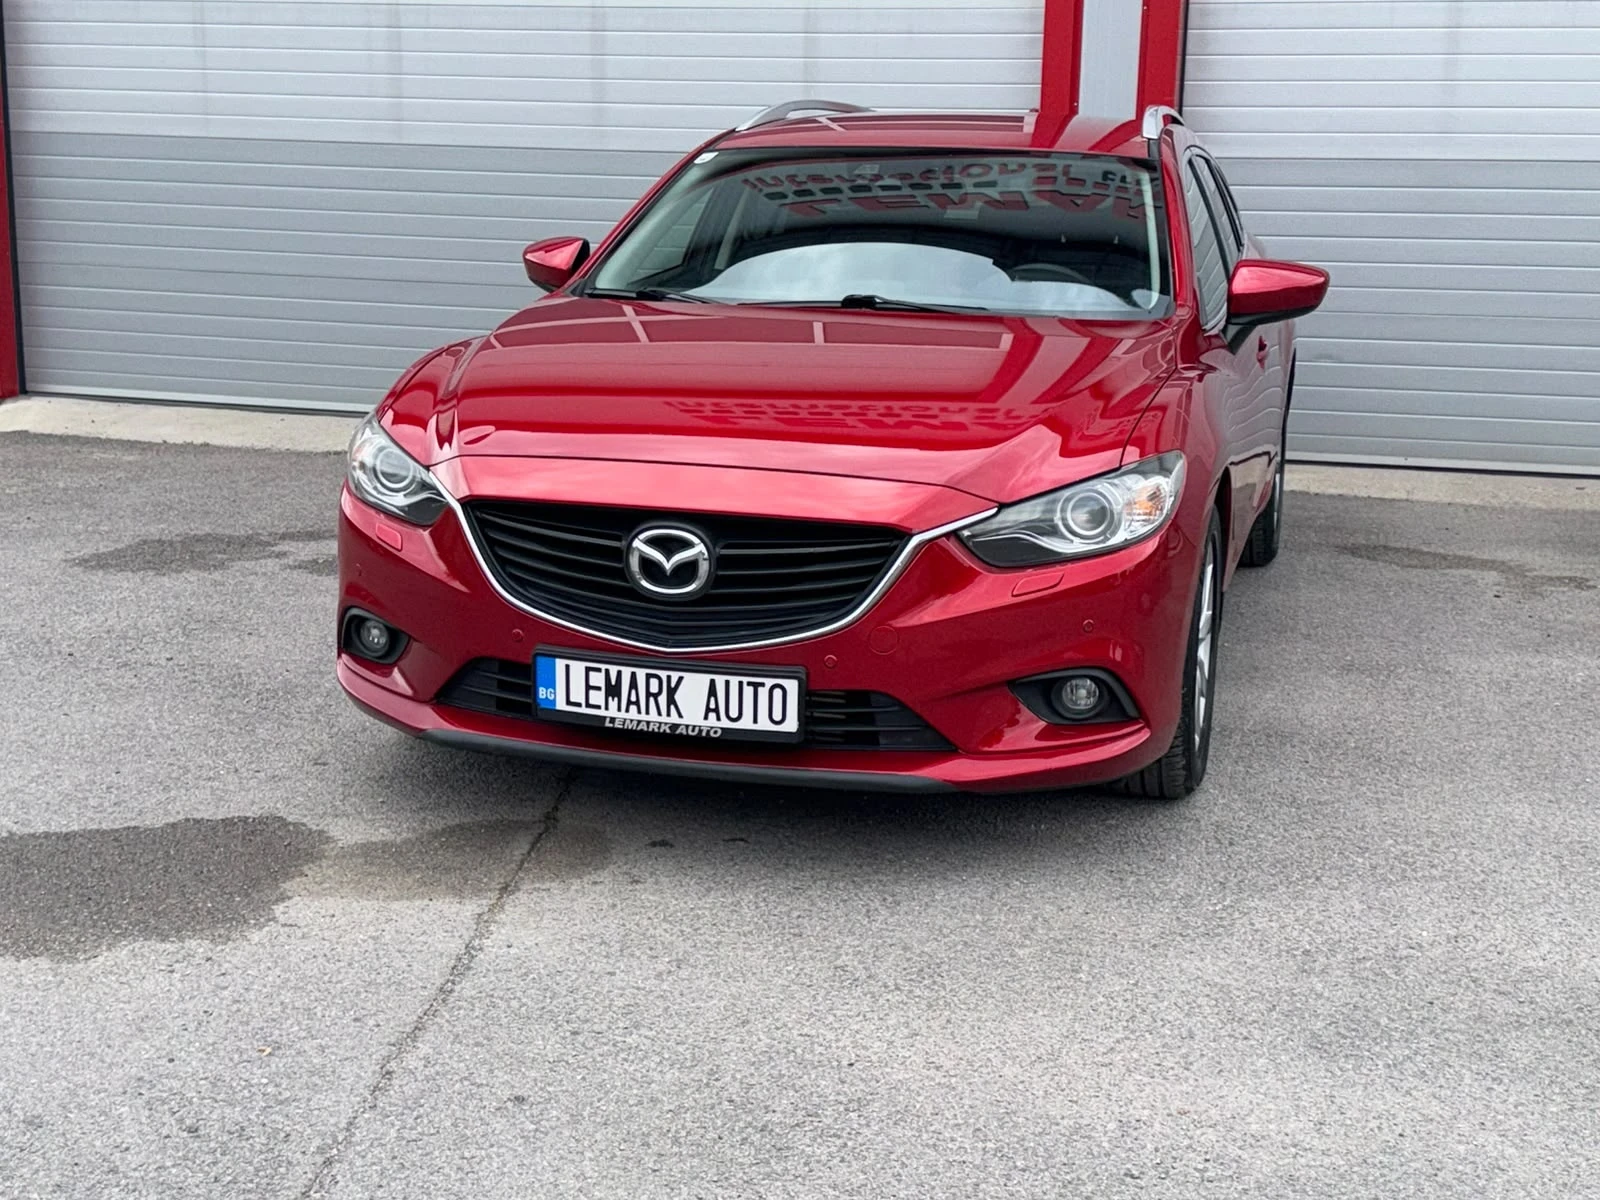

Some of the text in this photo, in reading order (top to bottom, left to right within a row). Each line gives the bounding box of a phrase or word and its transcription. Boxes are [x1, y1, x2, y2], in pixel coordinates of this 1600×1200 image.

[538, 686, 555, 700] BG
[564, 664, 788, 726] LEMARK AUTO
[604, 717, 722, 738] LEMARK AUTO
